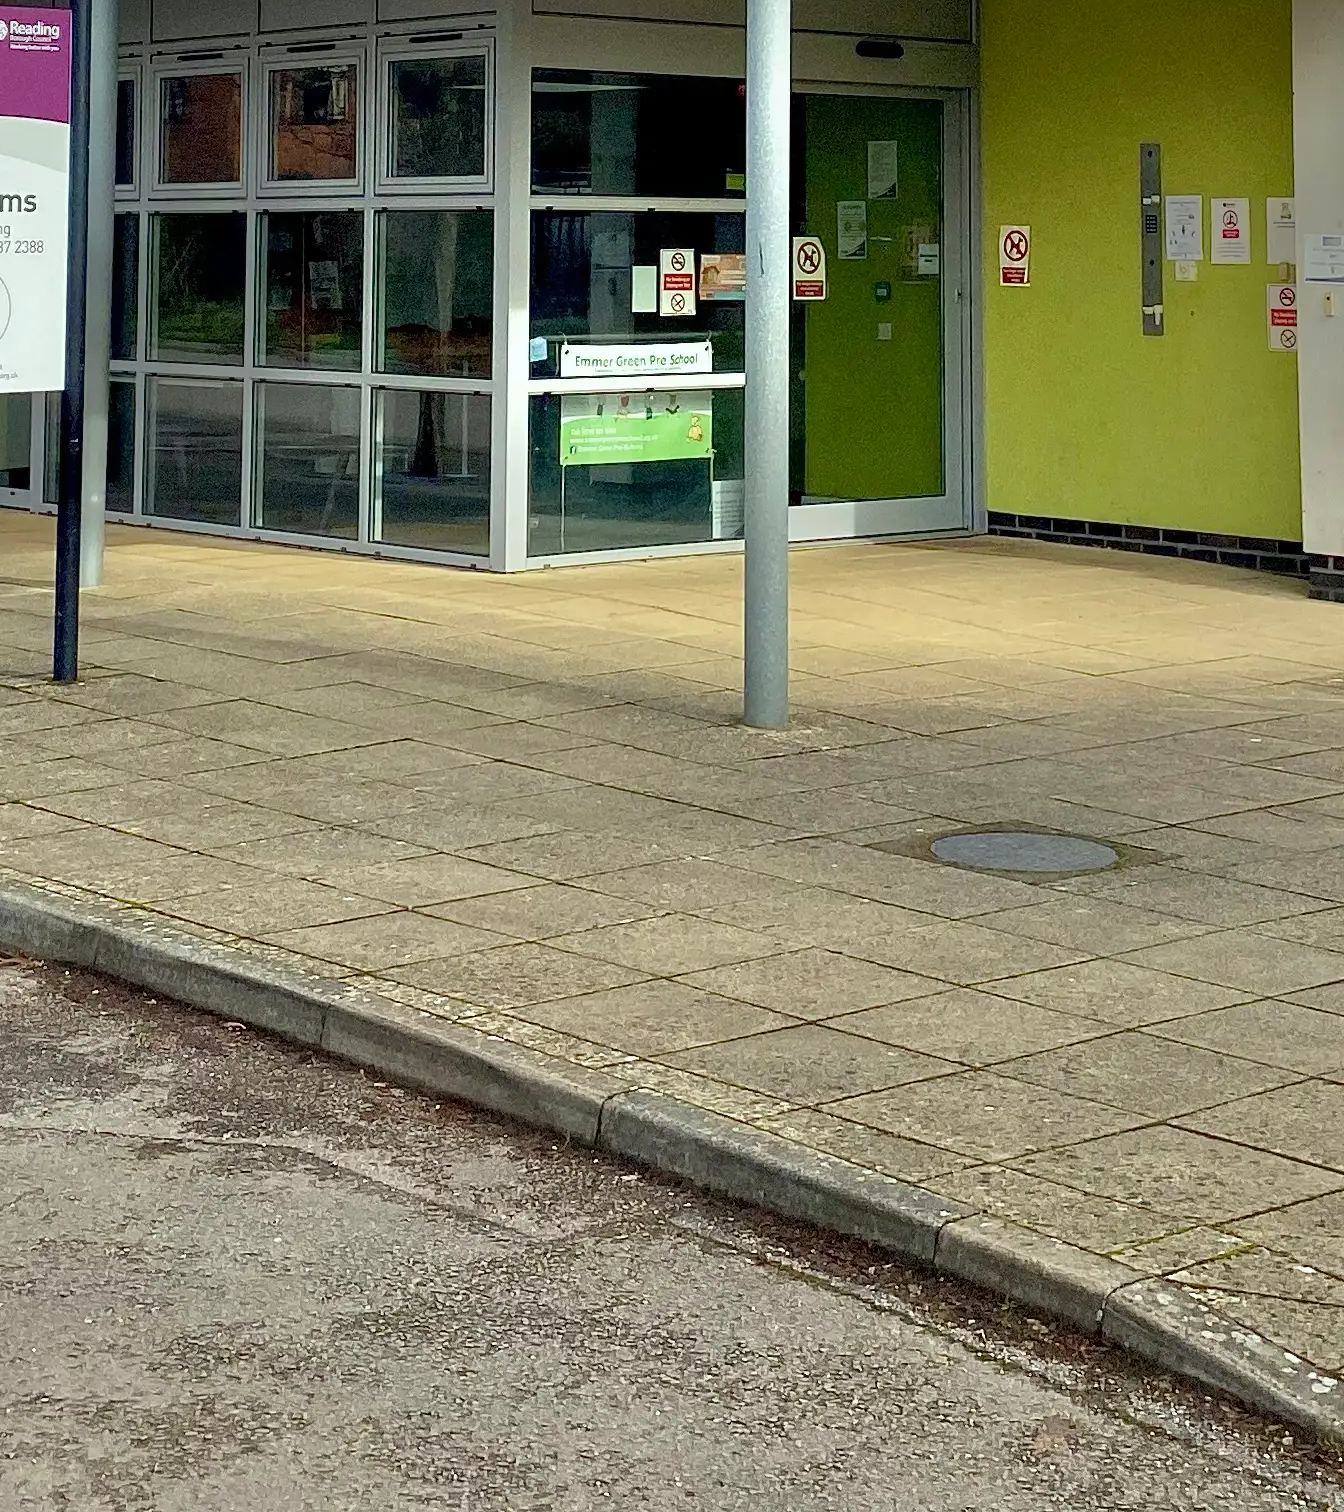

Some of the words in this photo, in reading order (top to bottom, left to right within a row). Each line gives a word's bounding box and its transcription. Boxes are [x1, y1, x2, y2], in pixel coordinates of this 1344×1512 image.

[9, 20, 60, 40] Reading
[14, 240, 44, 254] 2388
[575, 355, 613, 367] Emmer
[616, 355, 647, 367] Green
[650, 354, 667, 366] Pre
[669, 353, 698, 365] School
